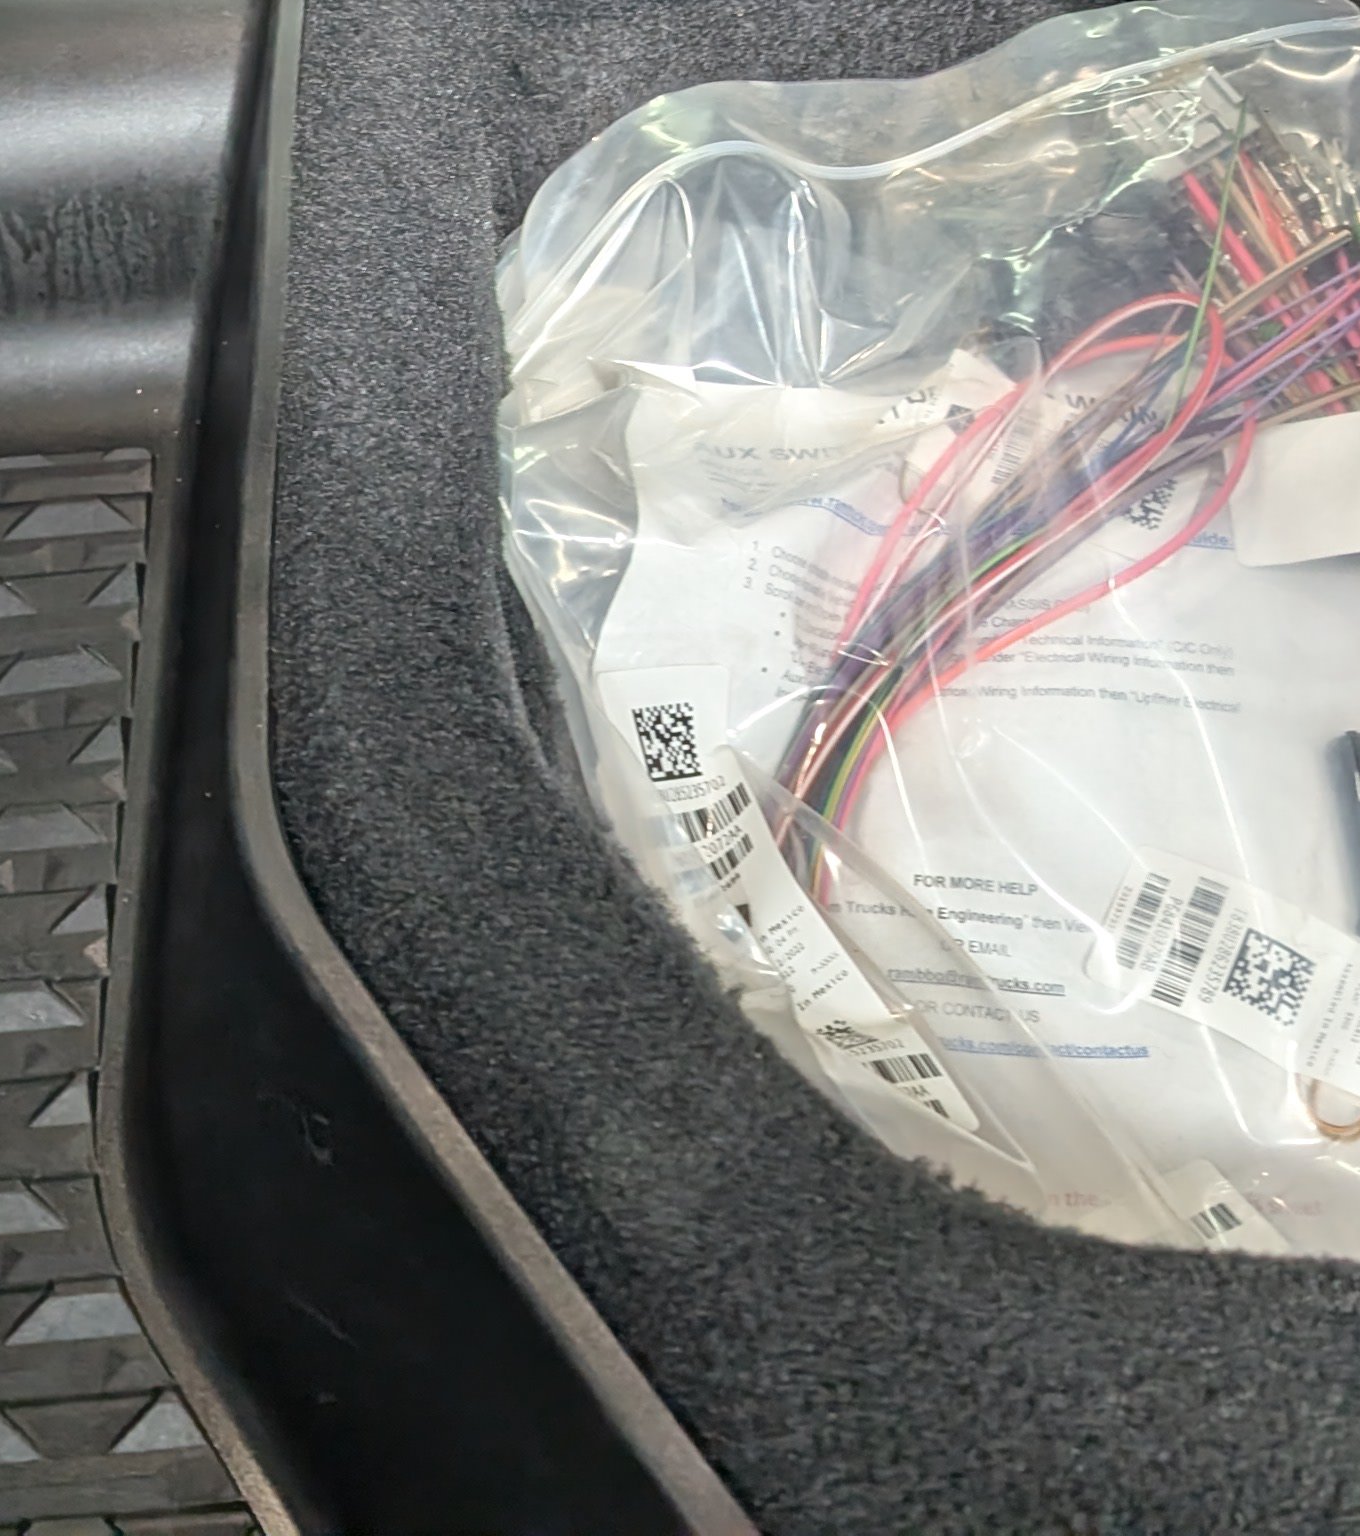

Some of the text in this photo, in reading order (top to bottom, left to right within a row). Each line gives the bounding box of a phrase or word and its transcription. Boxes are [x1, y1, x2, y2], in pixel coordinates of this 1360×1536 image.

[914, 874, 1038, 896] FOR MORE HELP
[847, 900, 896, 915] Trucks
[969, 939, 1012, 957] EMAIL
